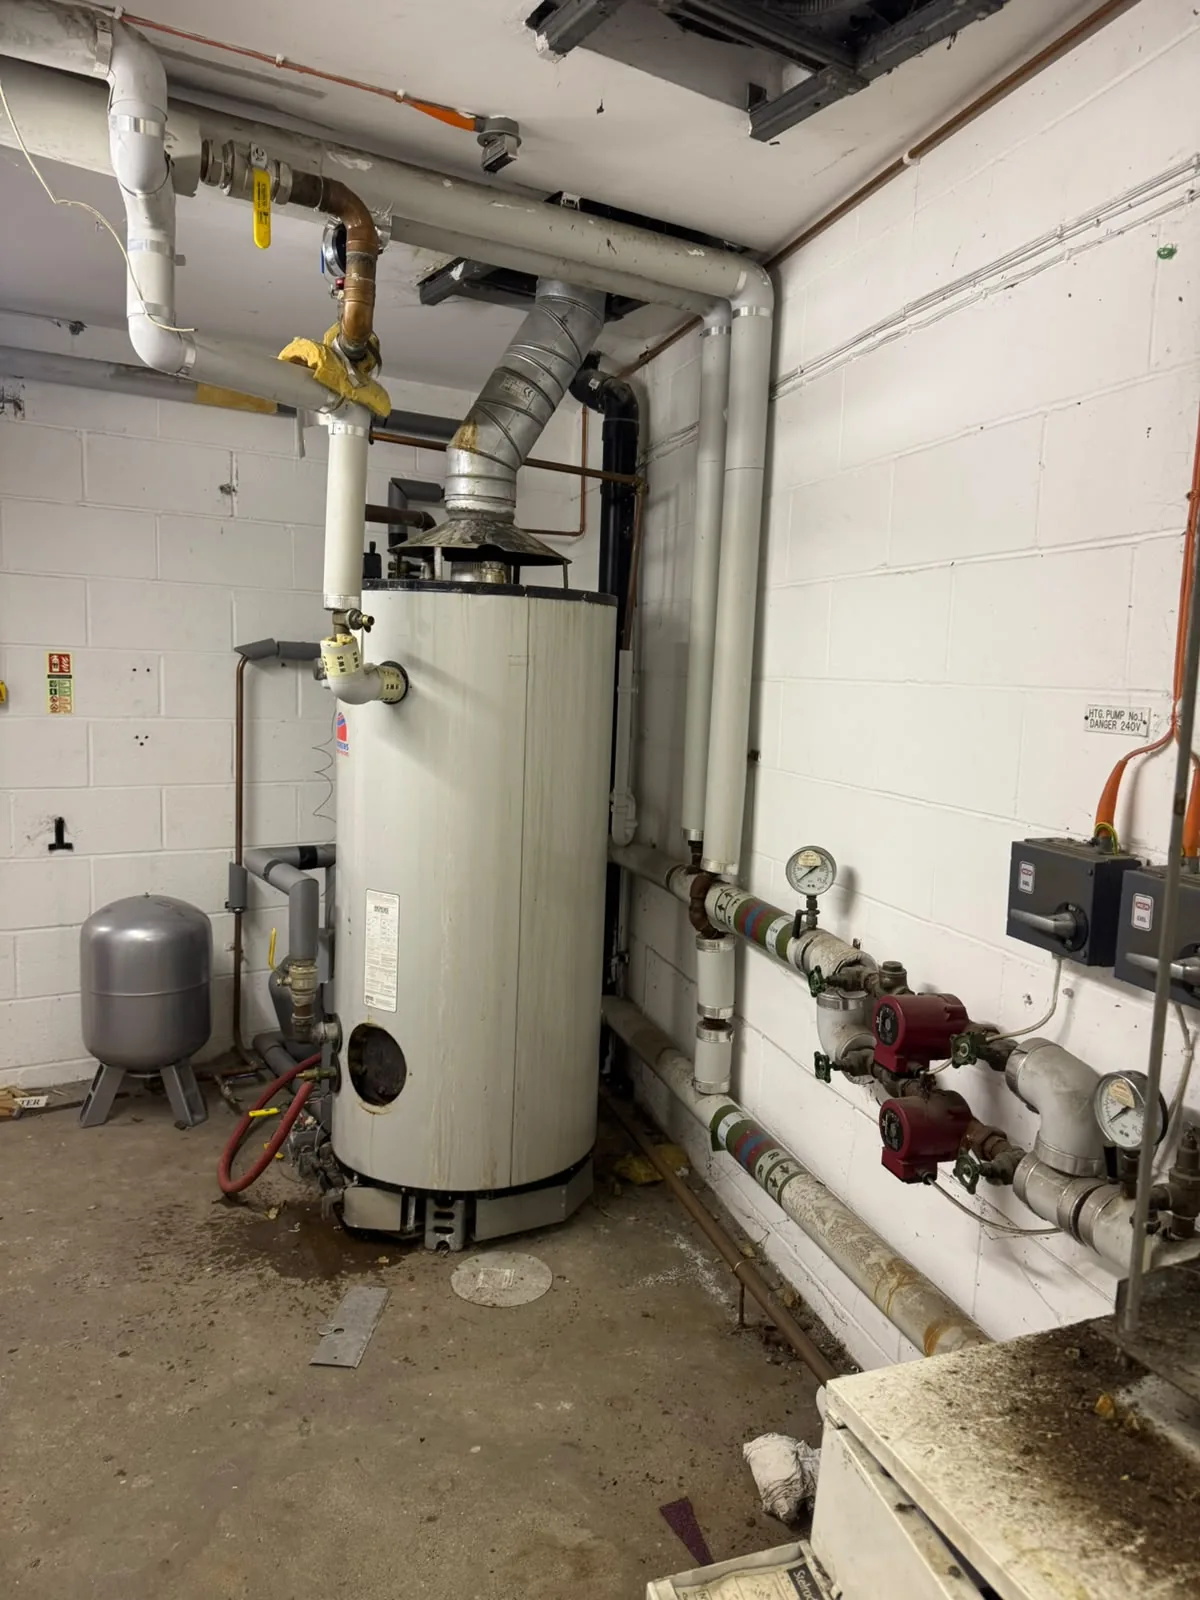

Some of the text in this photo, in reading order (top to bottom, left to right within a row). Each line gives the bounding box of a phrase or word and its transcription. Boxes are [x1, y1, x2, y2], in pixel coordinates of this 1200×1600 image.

[1106, 710, 1124, 719] PUMP
[1090, 719, 1141, 731] DANGER 240V
